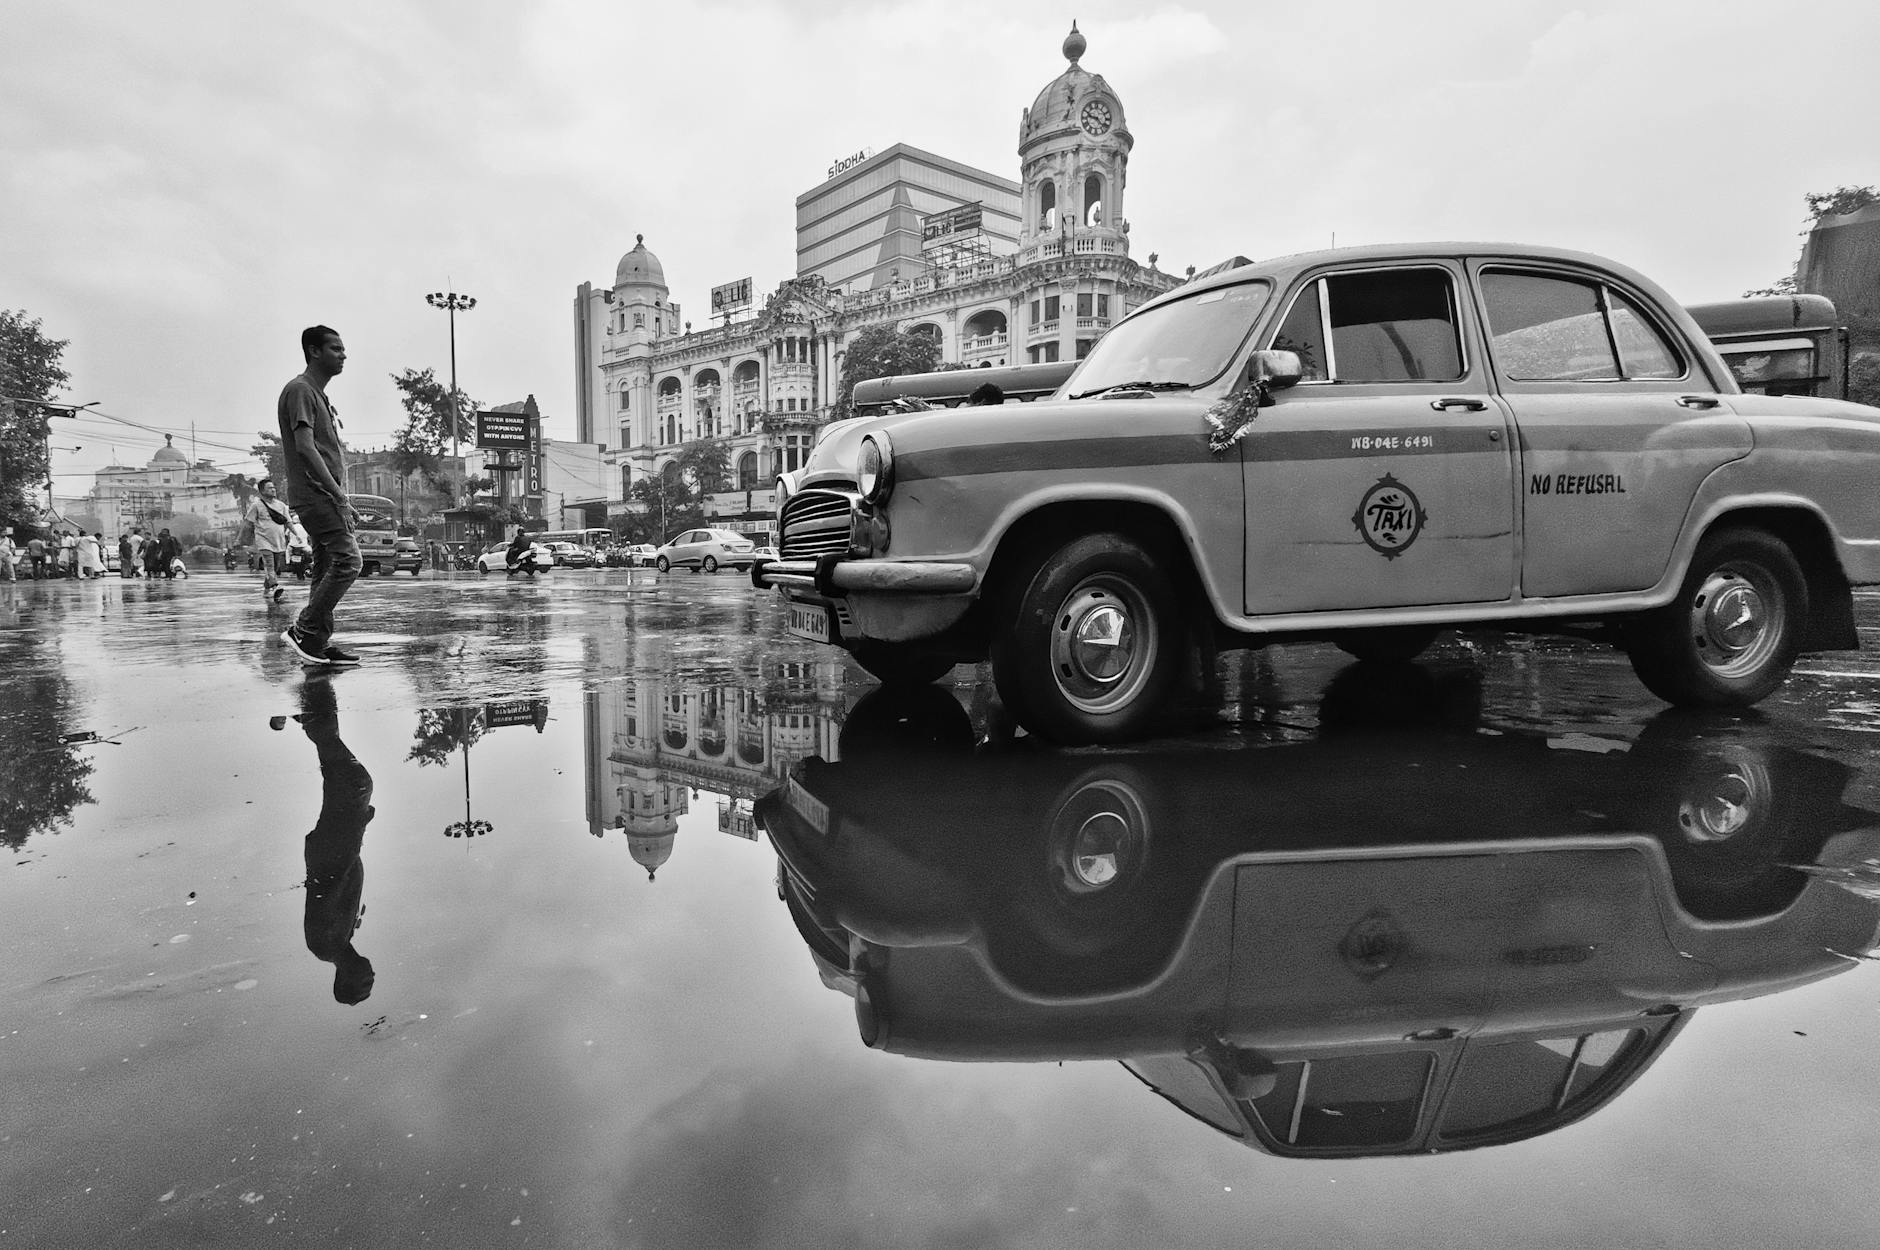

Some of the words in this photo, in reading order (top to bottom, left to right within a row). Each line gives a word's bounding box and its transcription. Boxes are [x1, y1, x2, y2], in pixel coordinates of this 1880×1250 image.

[937, 222, 952, 236] LIC
[731, 283, 748, 302] LIC
[529, 427, 538, 491] METRO
[1530, 474, 1551, 495] NO
[1555, 473, 1626, 495] REFUSAL
[1367, 494, 1413, 532] TAXI
